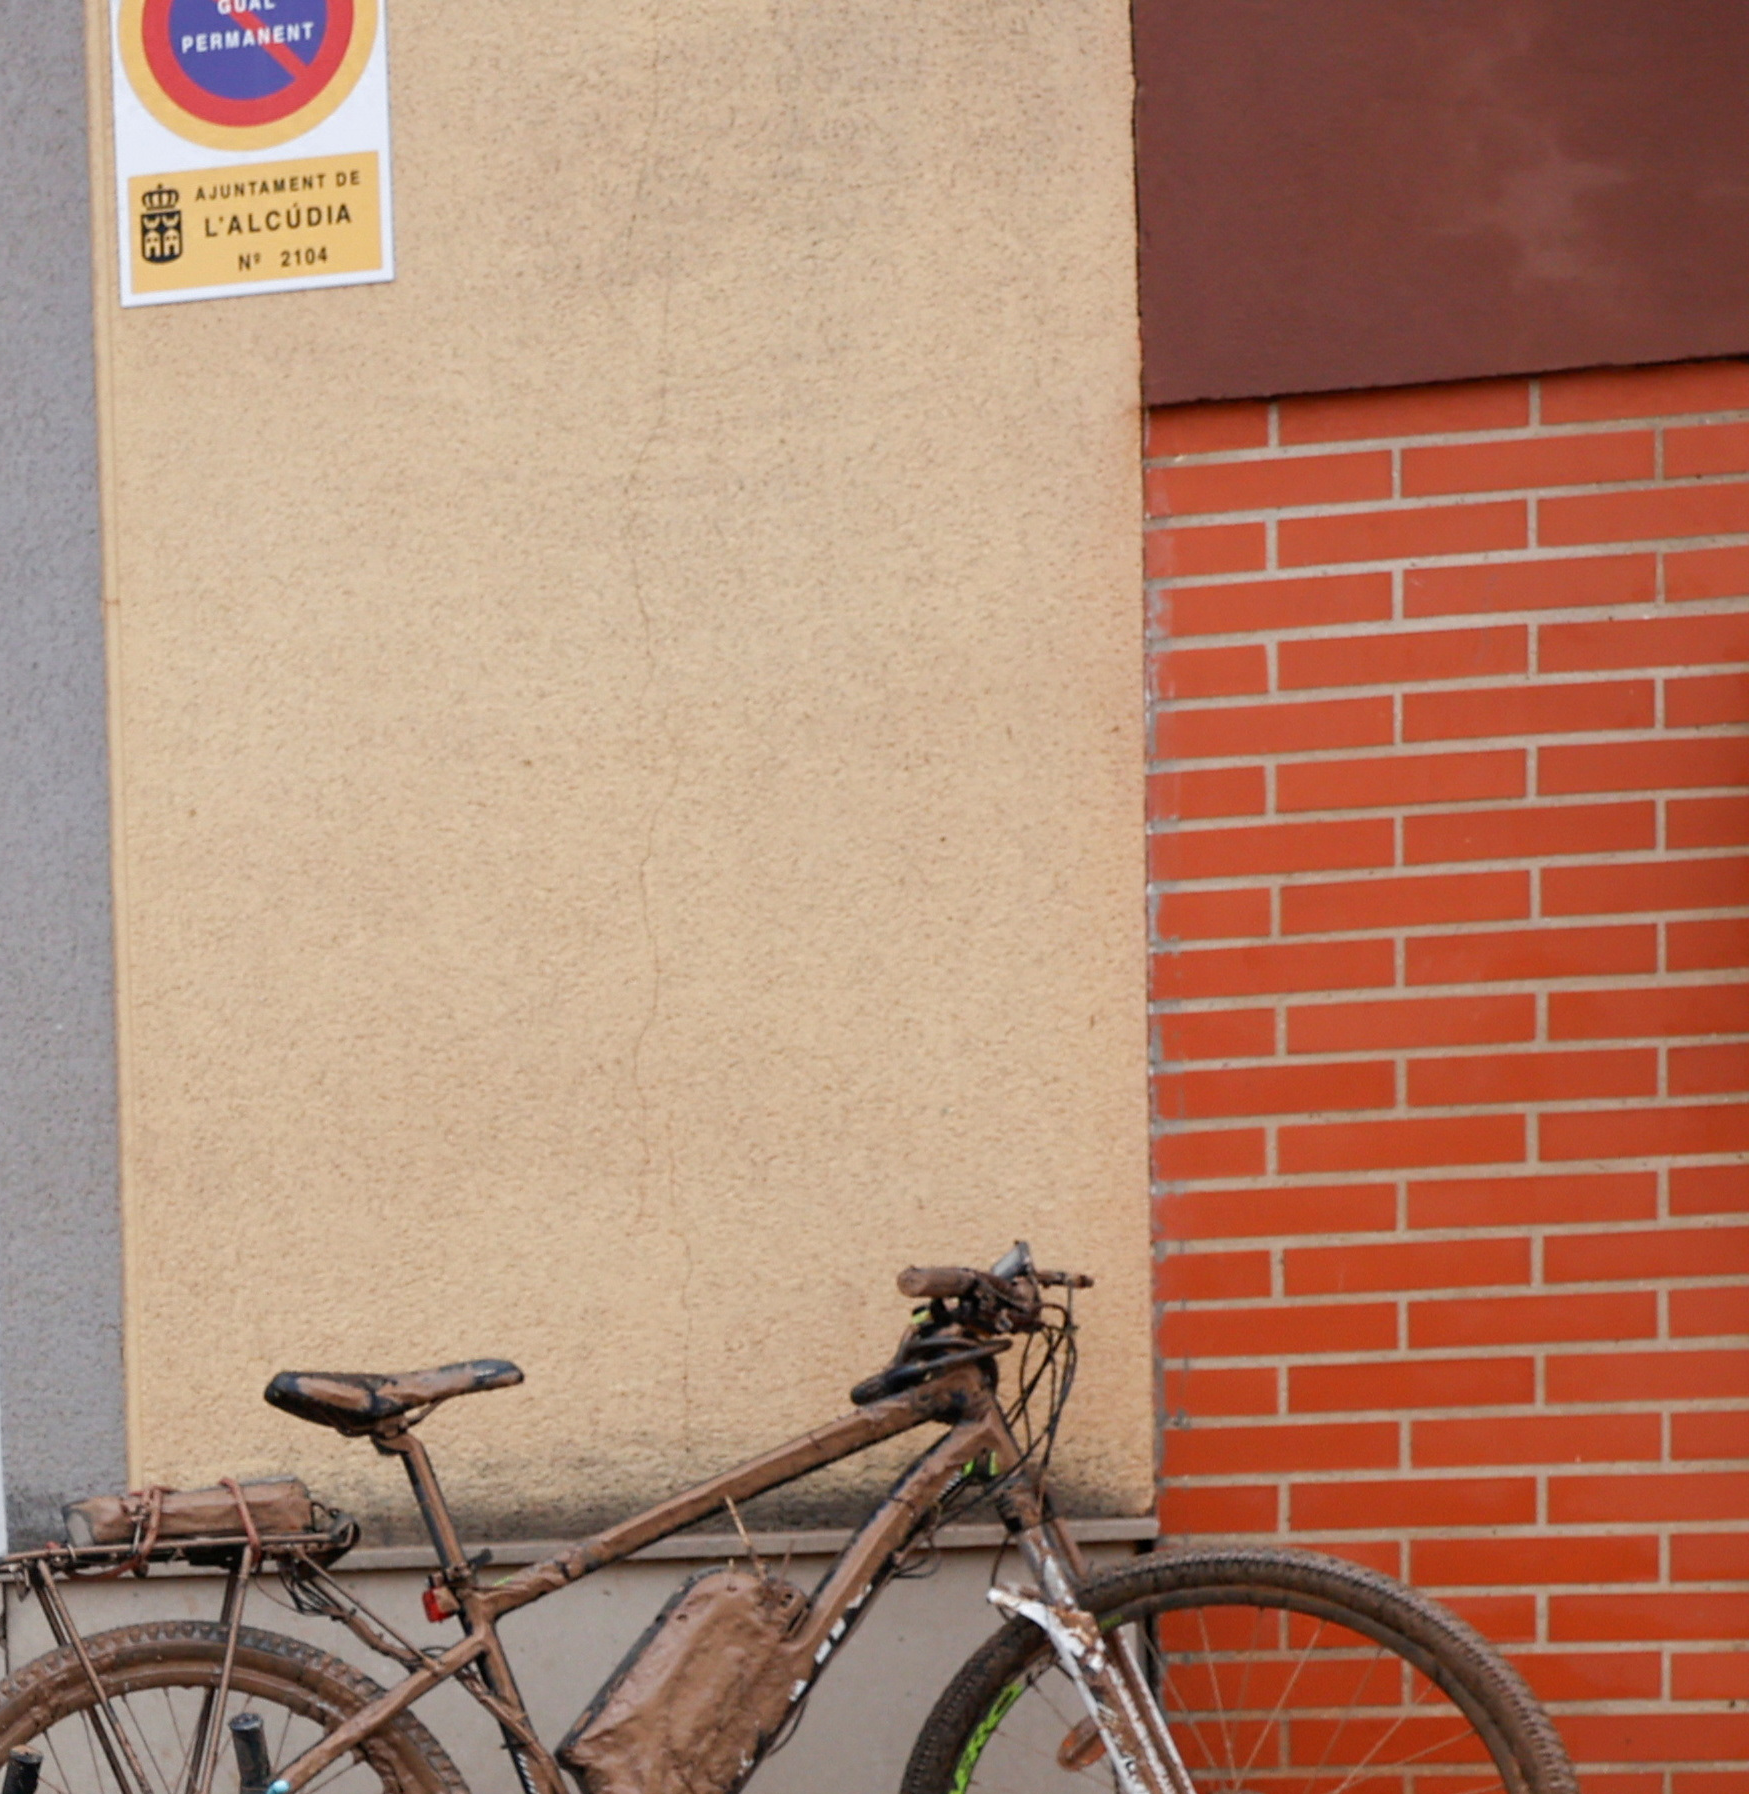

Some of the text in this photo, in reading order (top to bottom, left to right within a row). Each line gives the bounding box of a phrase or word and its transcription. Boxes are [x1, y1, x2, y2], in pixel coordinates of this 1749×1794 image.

[181, 21, 314, 54] PERMANENT
[194, 170, 361, 202] AJUNTAMENT DE
[204, 202, 352, 238] L'ALCÚDIA
[280, 247, 328, 268] 2104
